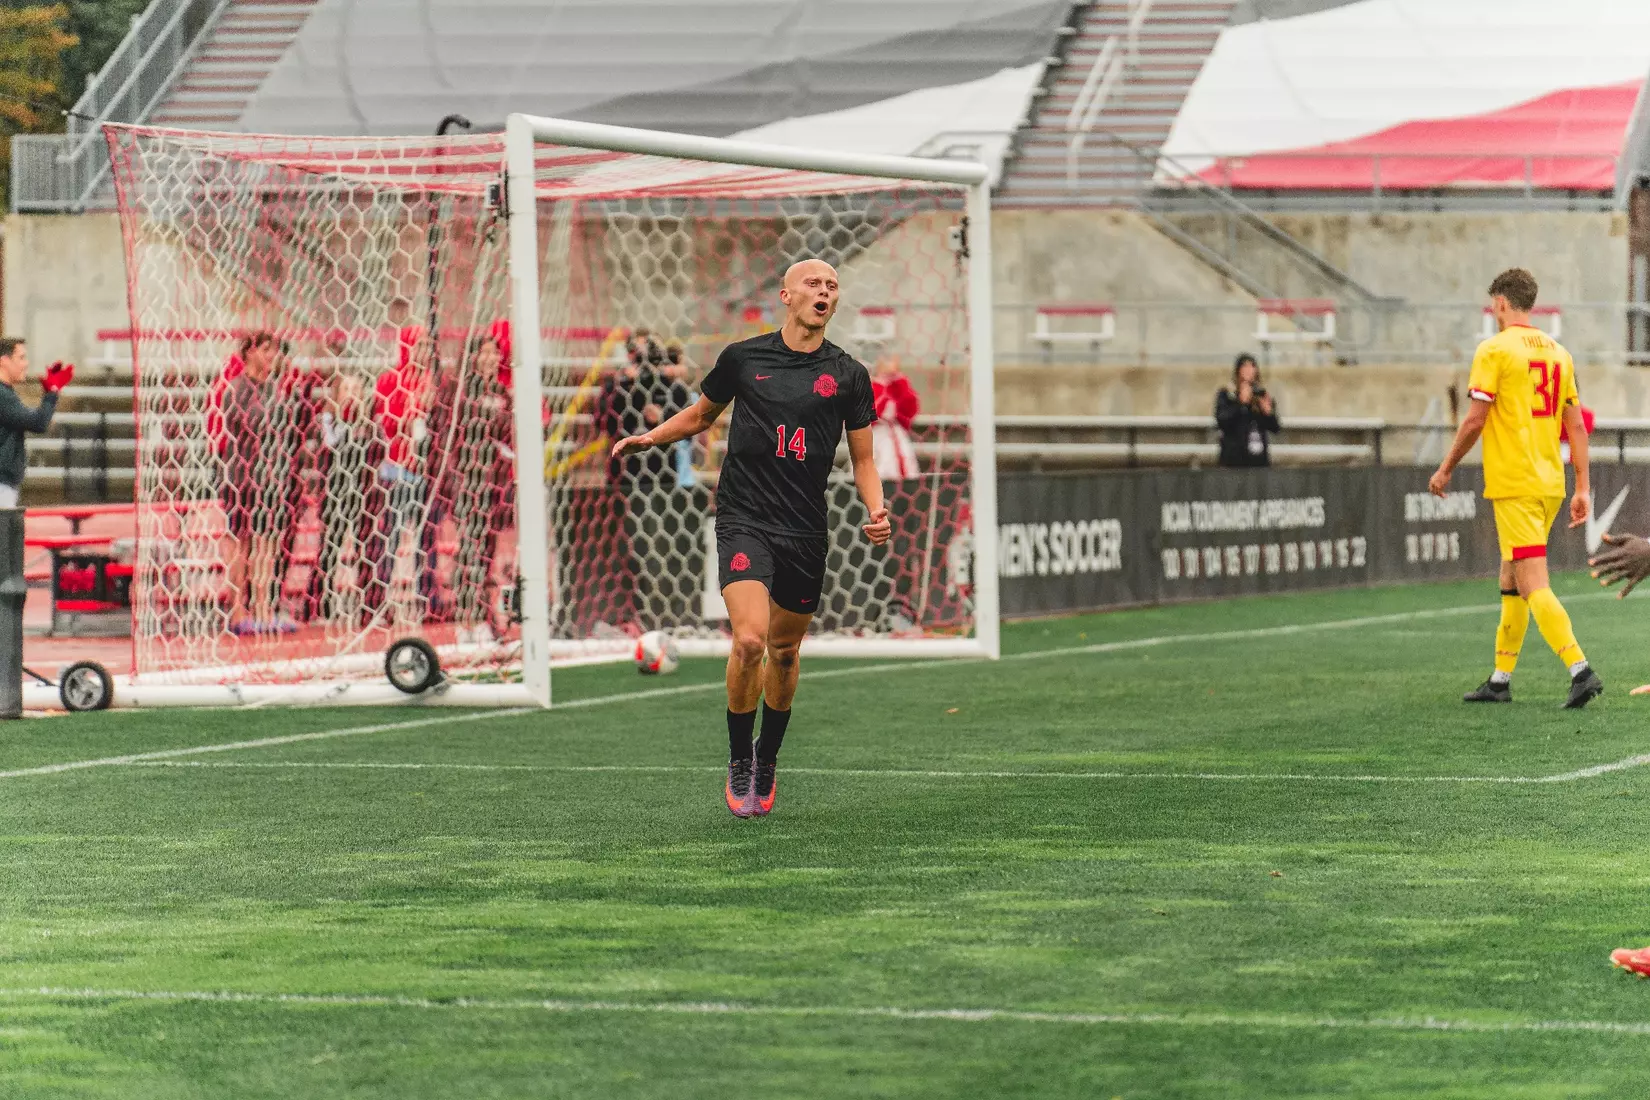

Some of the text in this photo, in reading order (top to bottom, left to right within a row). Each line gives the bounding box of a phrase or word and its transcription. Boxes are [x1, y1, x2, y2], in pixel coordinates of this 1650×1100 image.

[1528, 359, 1561, 418] 31
[776, 424, 806, 461] 14
[1050, 518, 1122, 576] SOCCER
